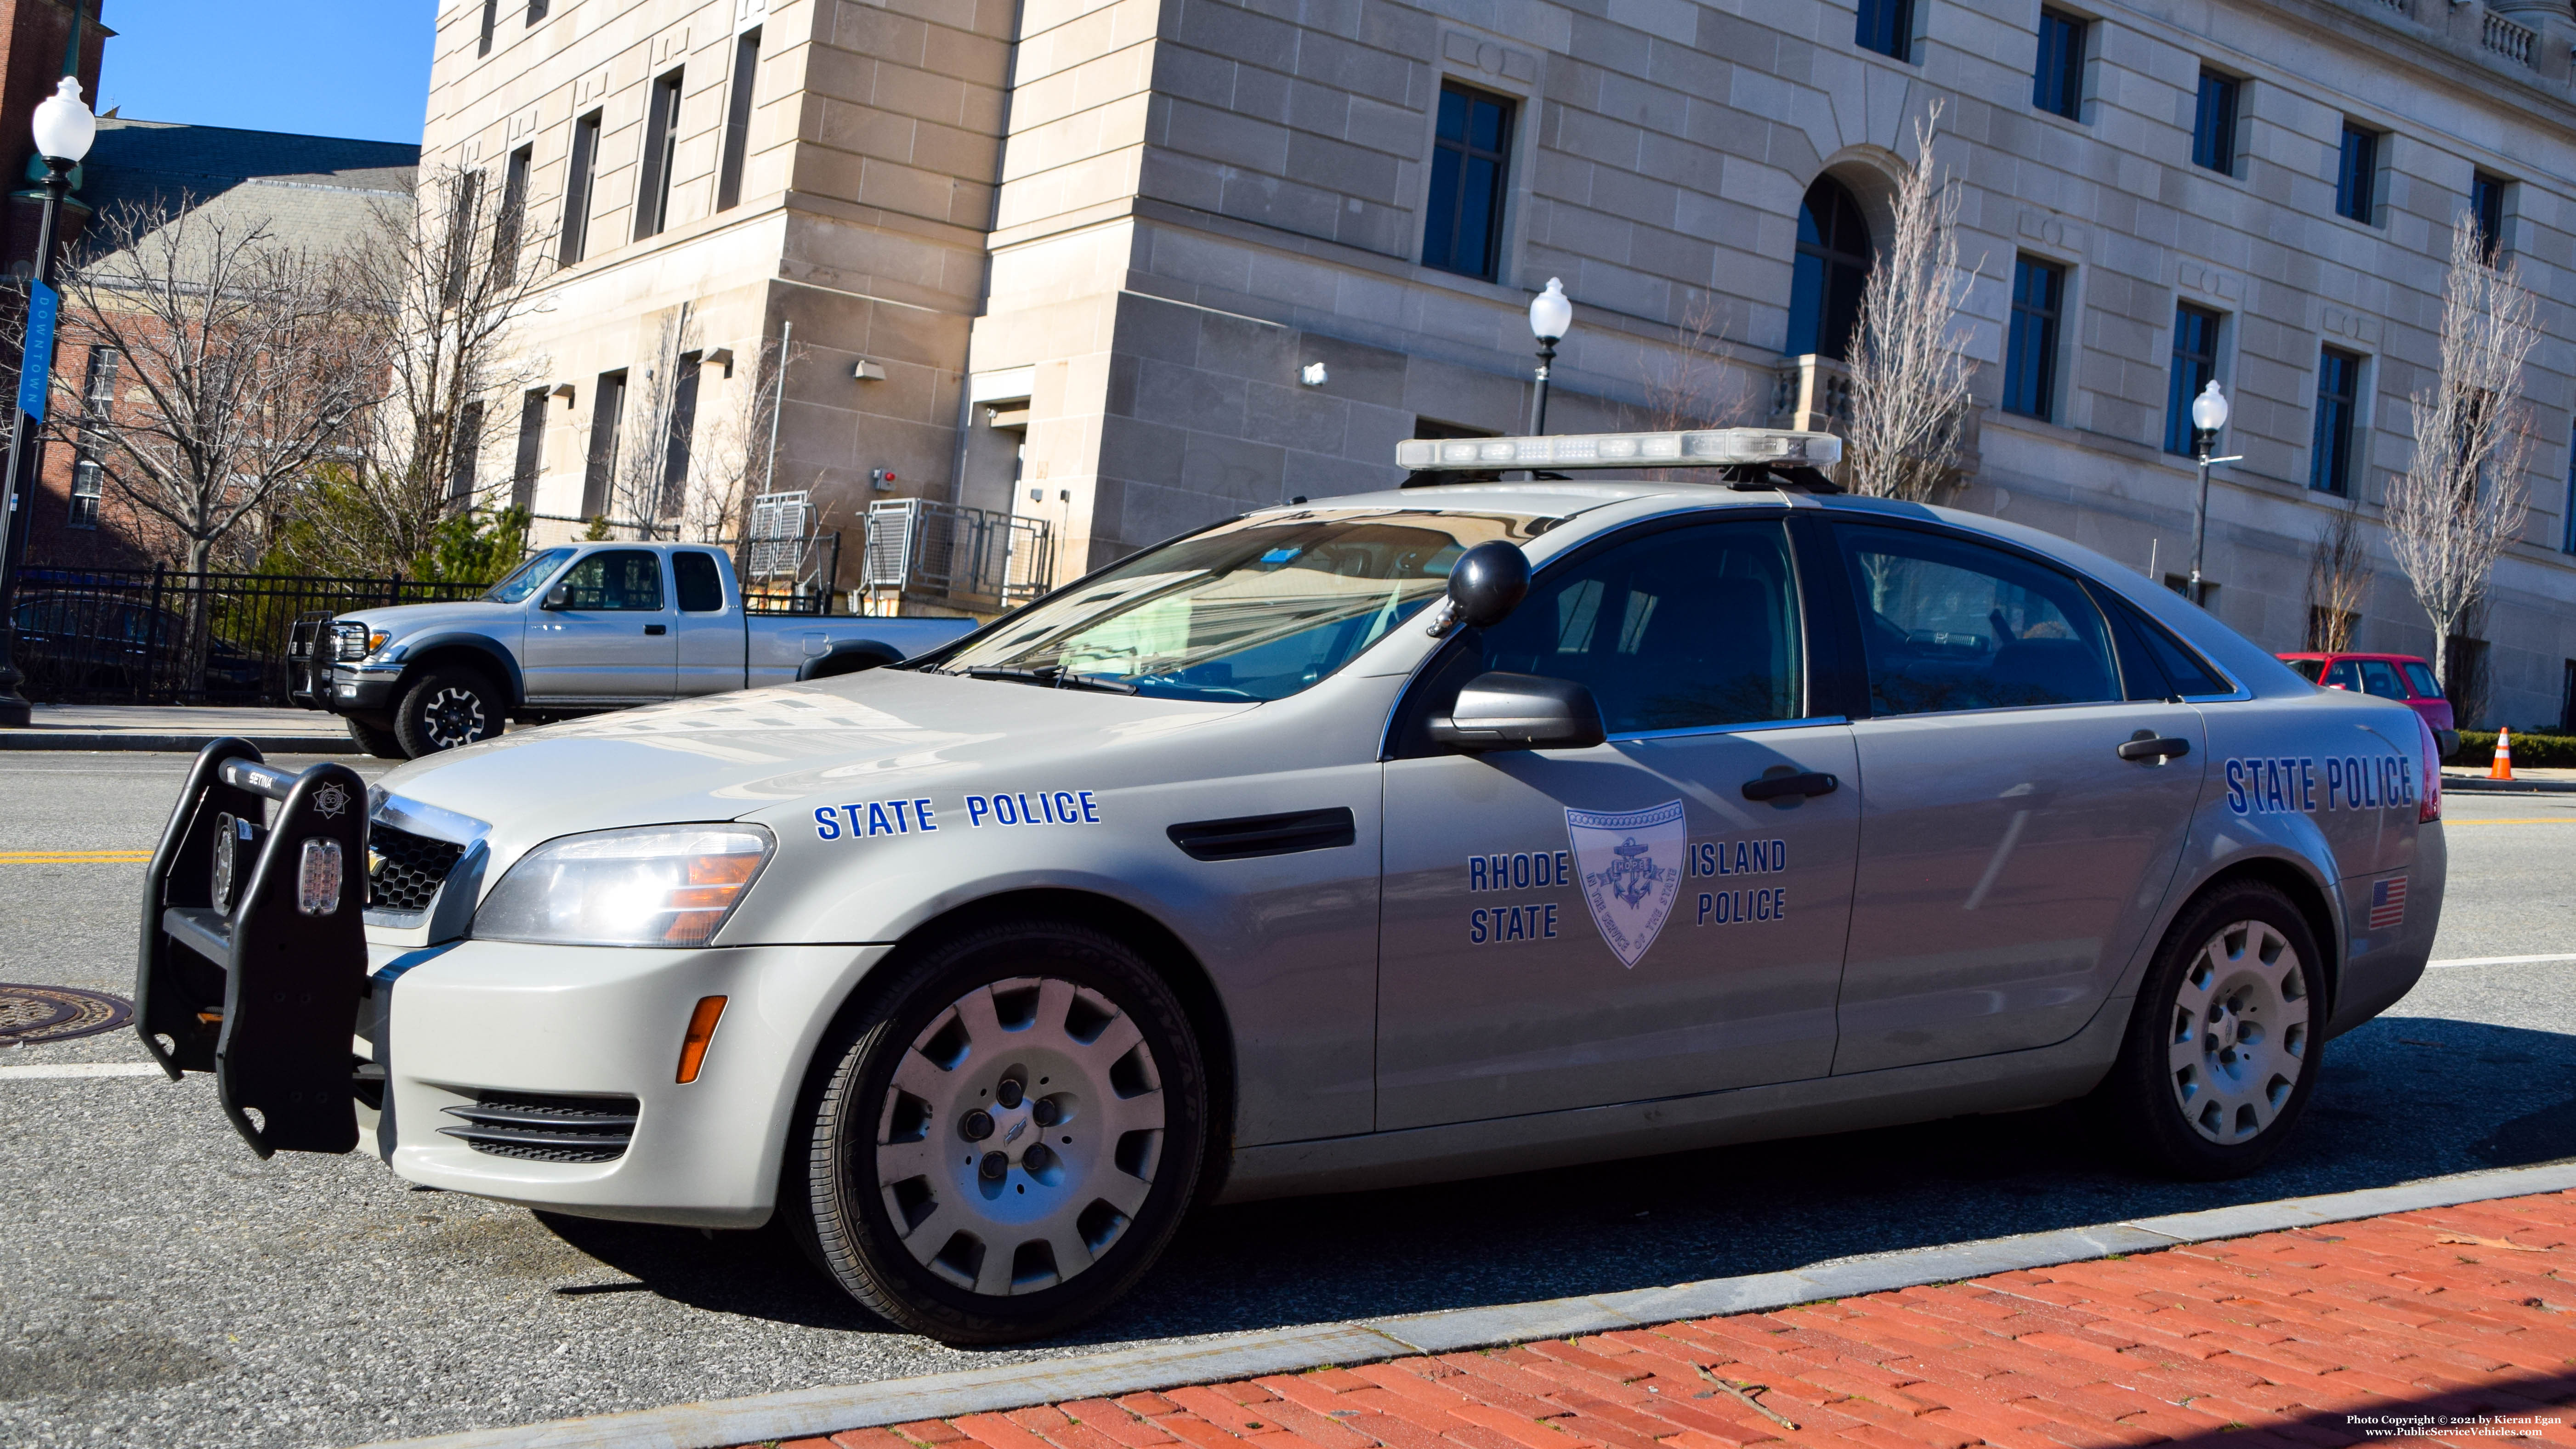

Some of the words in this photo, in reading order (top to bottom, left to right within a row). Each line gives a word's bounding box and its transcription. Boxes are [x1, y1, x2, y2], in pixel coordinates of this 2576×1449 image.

[28, 297, 49, 402] DOWNTOWN
[249, 772, 272, 789] SETINA
[2225, 756, 2316, 816] STATE
[2326, 754, 2412, 812] POLICE
[813, 798, 939, 841] STATE
[964, 790, 1101, 828] POLICE
[1469, 850, 1569, 892] RHODE
[1691, 839, 1786, 878] ISLAND
[1586, 872, 1597, 888] IN
[1618, 860, 1644, 871] HOPE
[1591, 888, 1606, 913] THE
[1660, 868, 1677, 906] STATE
[1470, 903, 1558, 945] STATE
[1697, 888, 1786, 927] POLICE
[1602, 911, 1630, 951] SERVICE
[1645, 907, 1663, 931] THE
[1634, 933, 1646, 950] OF
